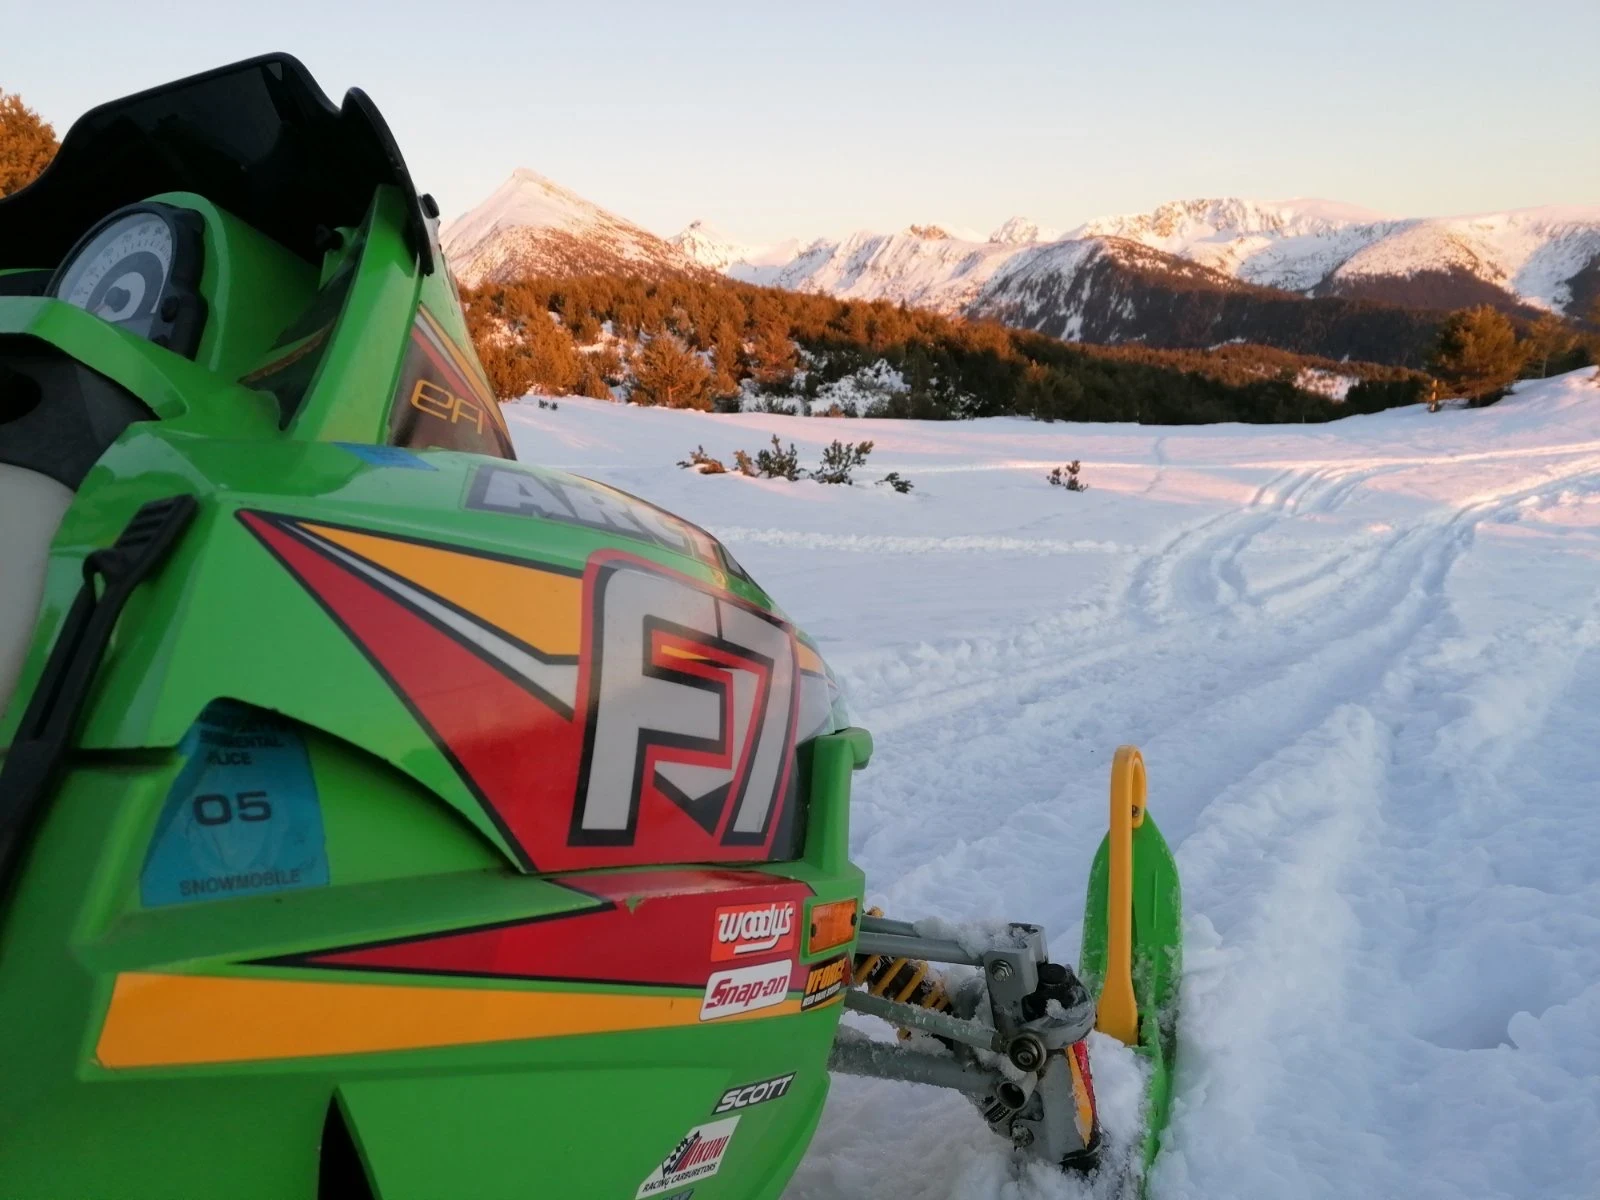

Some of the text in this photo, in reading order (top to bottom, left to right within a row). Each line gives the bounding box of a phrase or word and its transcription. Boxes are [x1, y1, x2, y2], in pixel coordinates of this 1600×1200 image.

[572, 562, 795, 842] F7
[179, 868, 301, 896] SNOWMOBILE
[705, 975, 788, 1009] Snap-on
[715, 1074, 794, 1113] SCOTT
[671, 1163, 717, 1184] CARBURETORS
